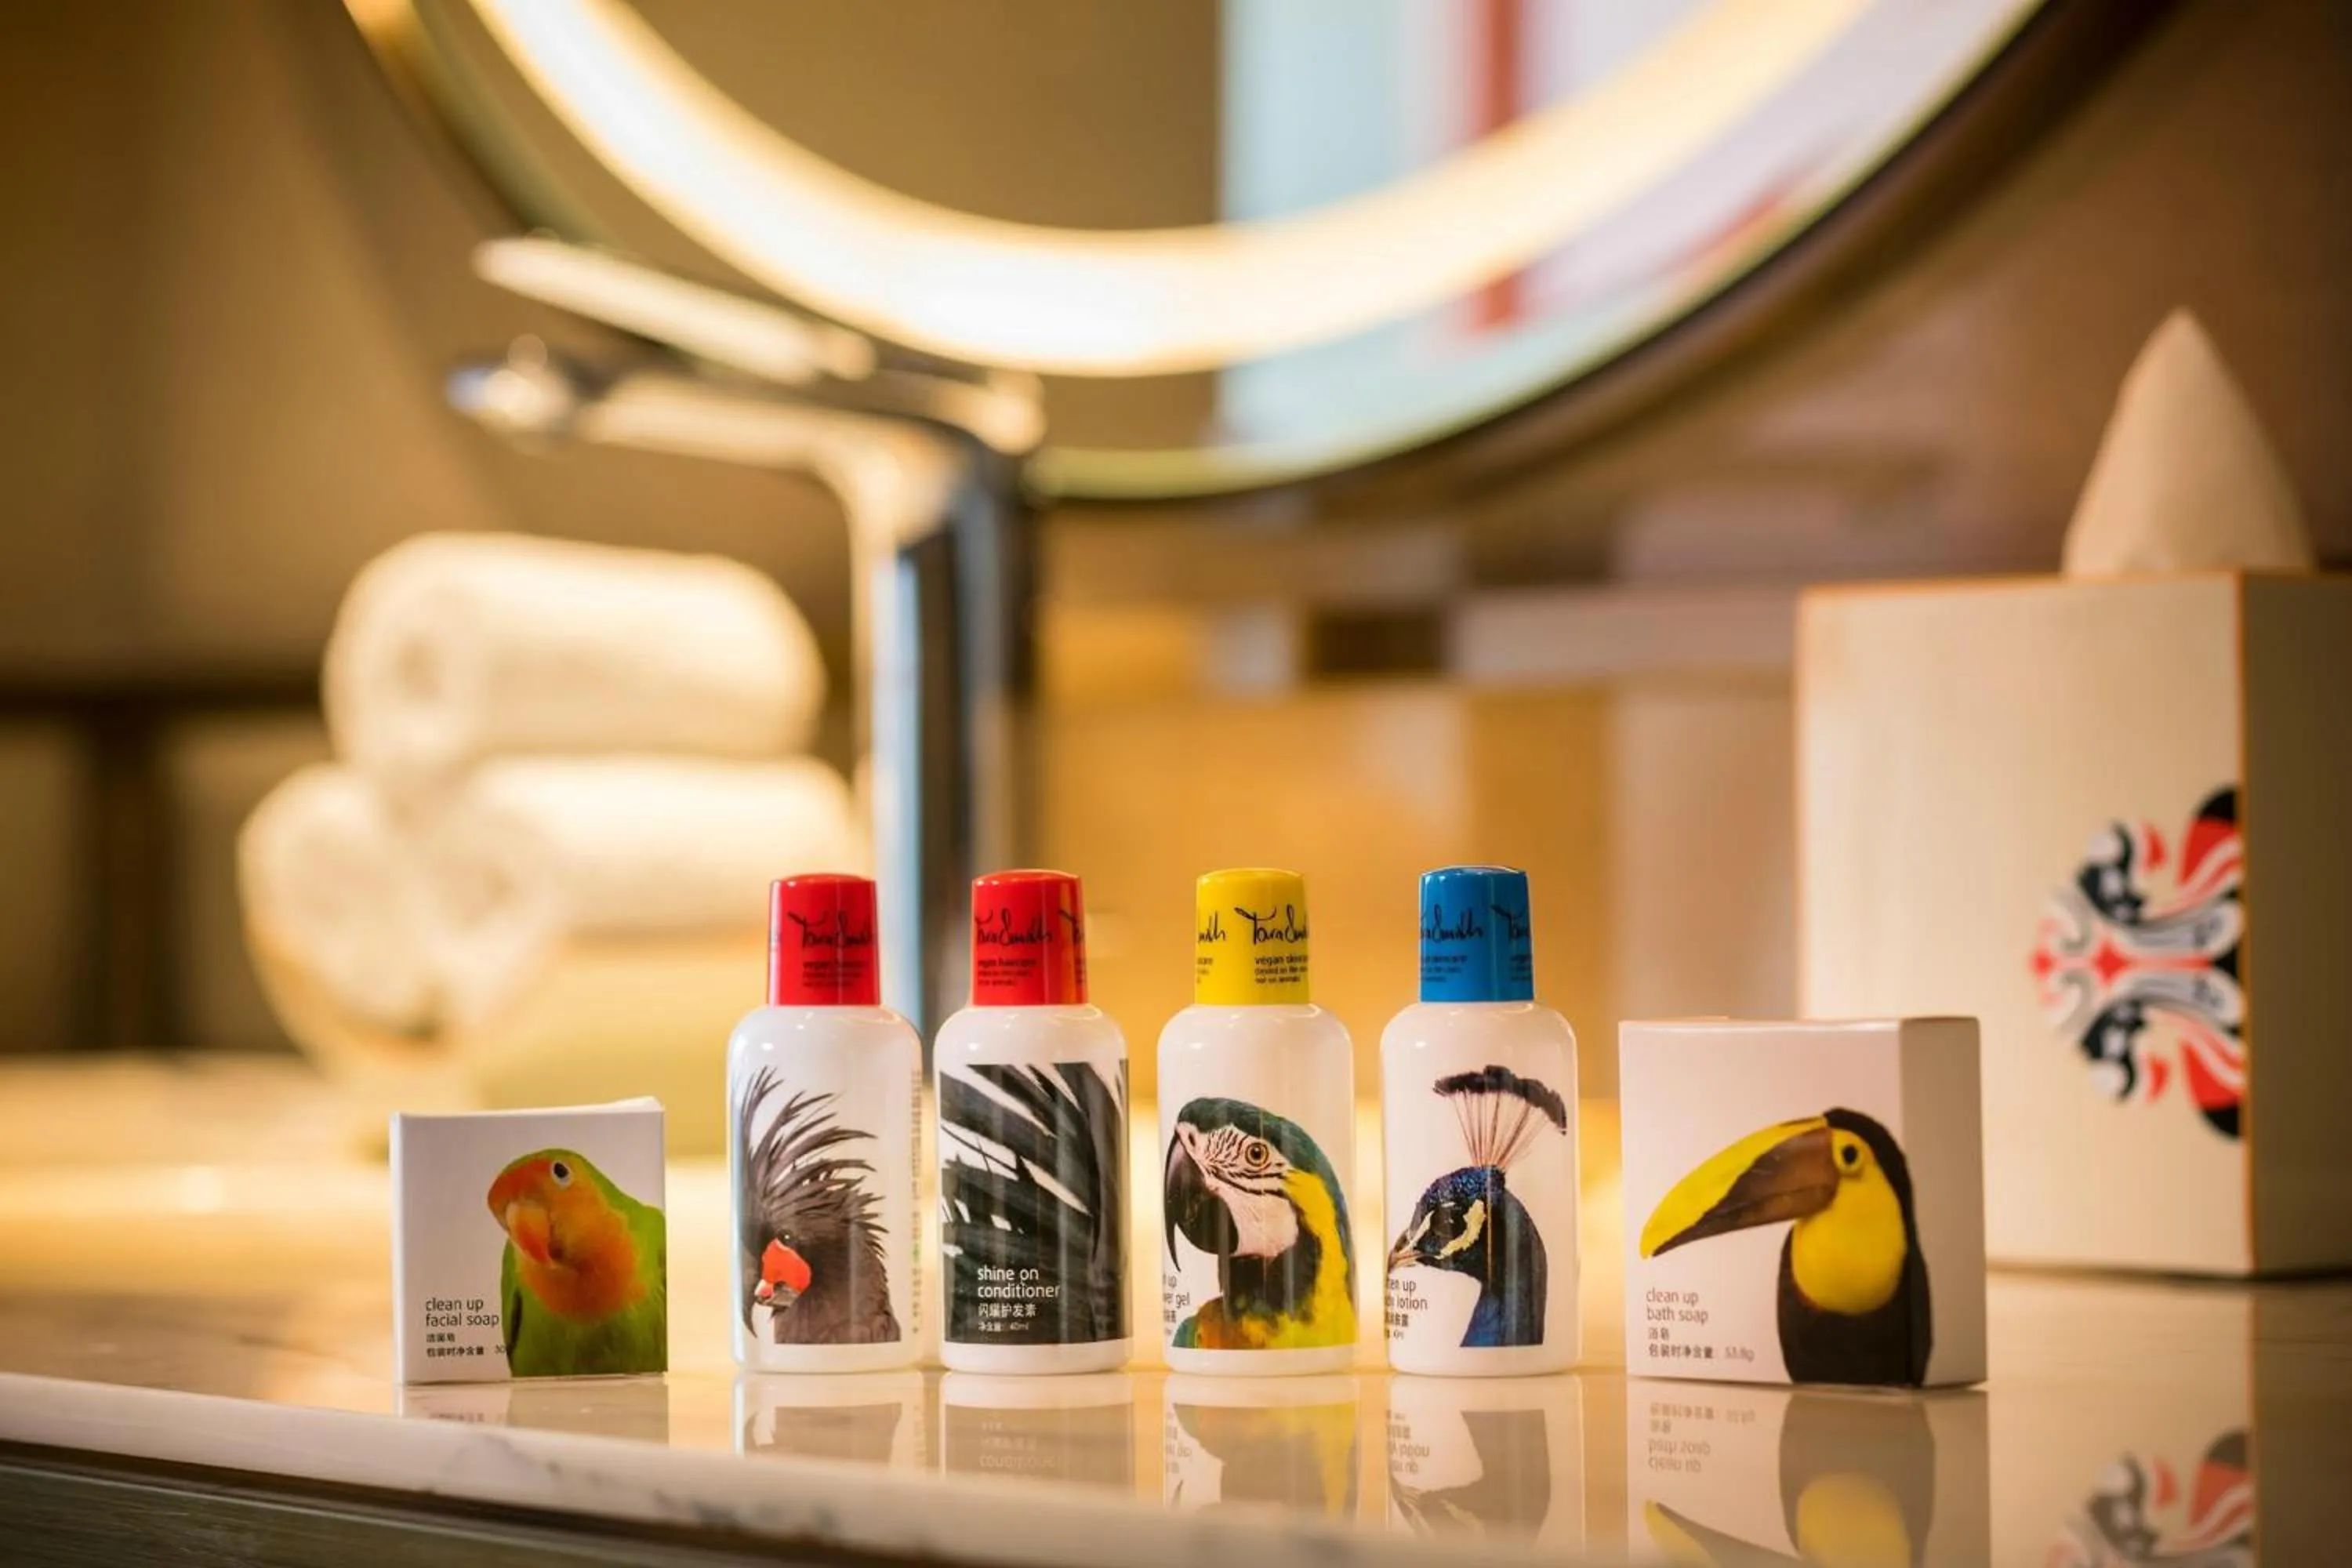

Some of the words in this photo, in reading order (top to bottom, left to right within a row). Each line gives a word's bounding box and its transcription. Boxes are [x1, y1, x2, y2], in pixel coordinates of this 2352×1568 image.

[977, 1265, 1015, 1281] shine
[1020, 1269, 1040, 1280] on
[978, 1282, 1061, 1298] conditioner
[1403, 1279, 1417, 1296] up
[426, 1298, 463, 1312] clean
[466, 1299, 485, 1313] up
[1397, 1294, 1428, 1311] lotion
[1646, 1287, 1679, 1303] clean
[1683, 1292, 1699, 1308] up
[426, 1313, 462, 1327] facial
[466, 1315, 499, 1328] soap
[1647, 1305, 1675, 1321] bath
[1679, 1308, 1709, 1326] soap
